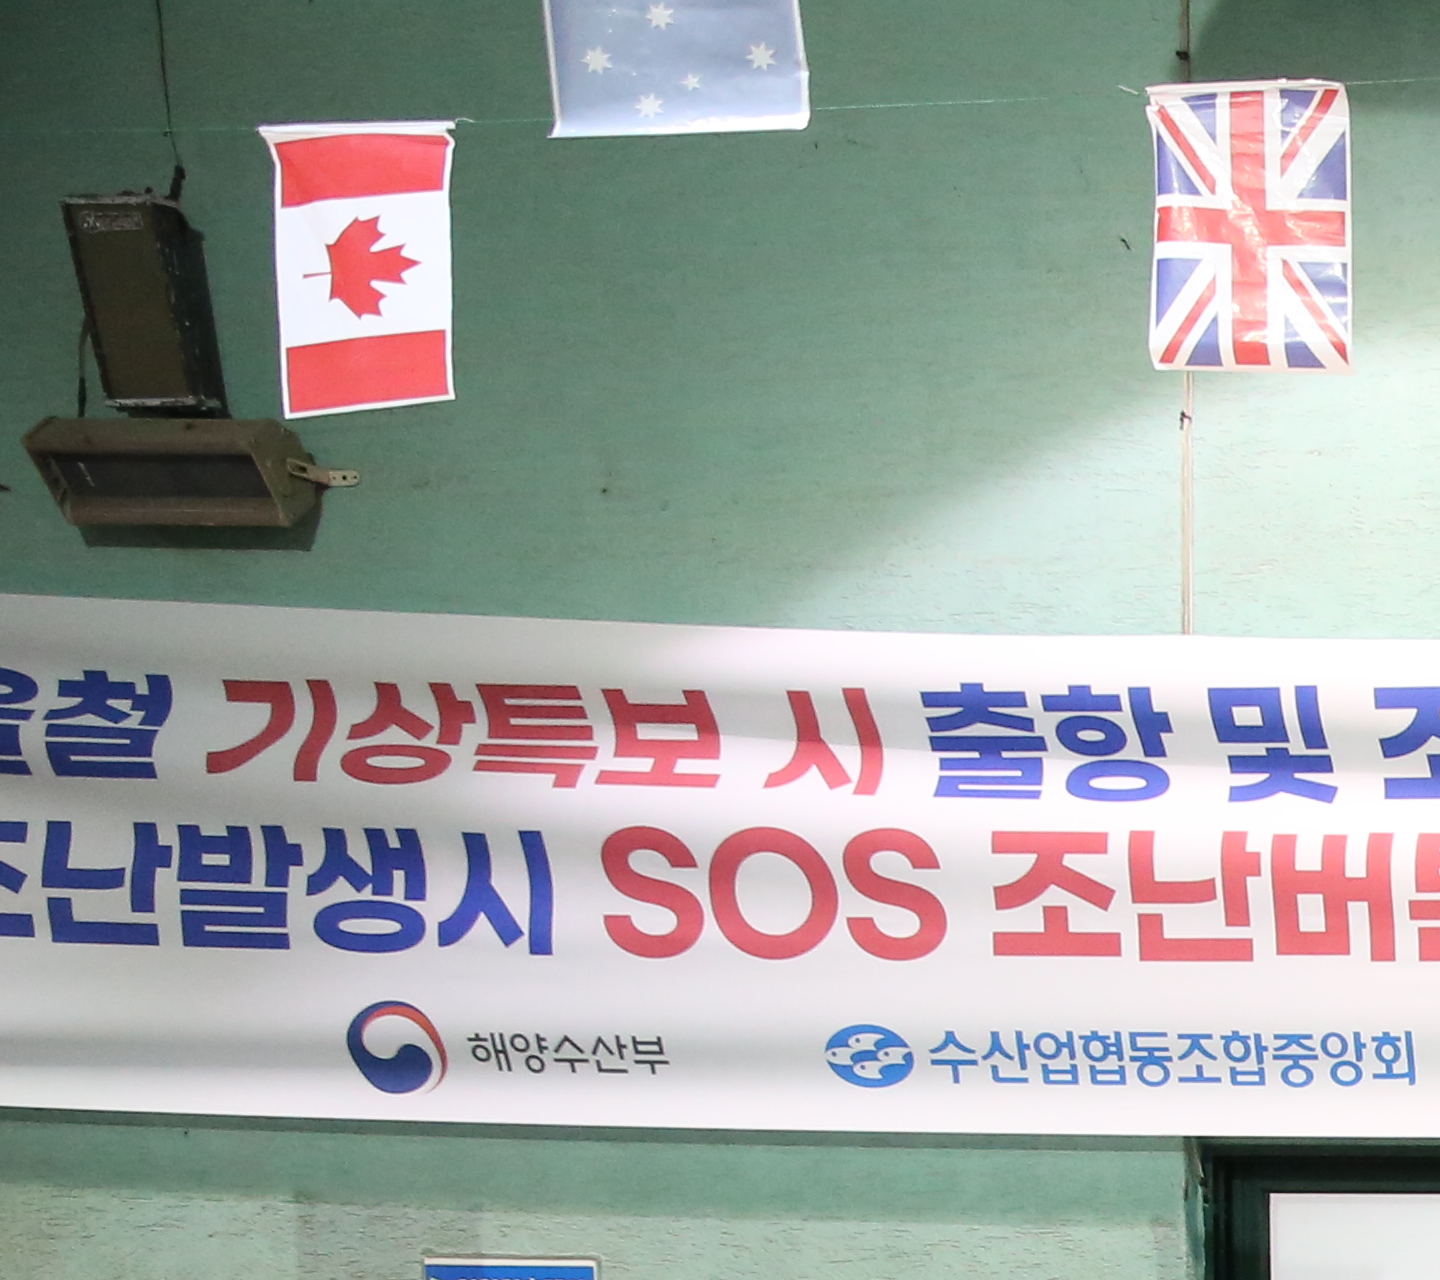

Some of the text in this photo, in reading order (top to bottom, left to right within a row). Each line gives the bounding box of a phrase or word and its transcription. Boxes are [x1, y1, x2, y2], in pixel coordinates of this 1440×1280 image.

[206, 679, 720, 790] 기상특보
[762, 686, 884, 797] 시
[919, 682, 1174, 803] 출항
[1207, 685, 1339, 804] 및
[601, 825, 949, 962] SOS
[467, 1029, 670, 1078] 해양수산부
[928, 1030, 1418, 1087] 수산업협동조합중앙회
